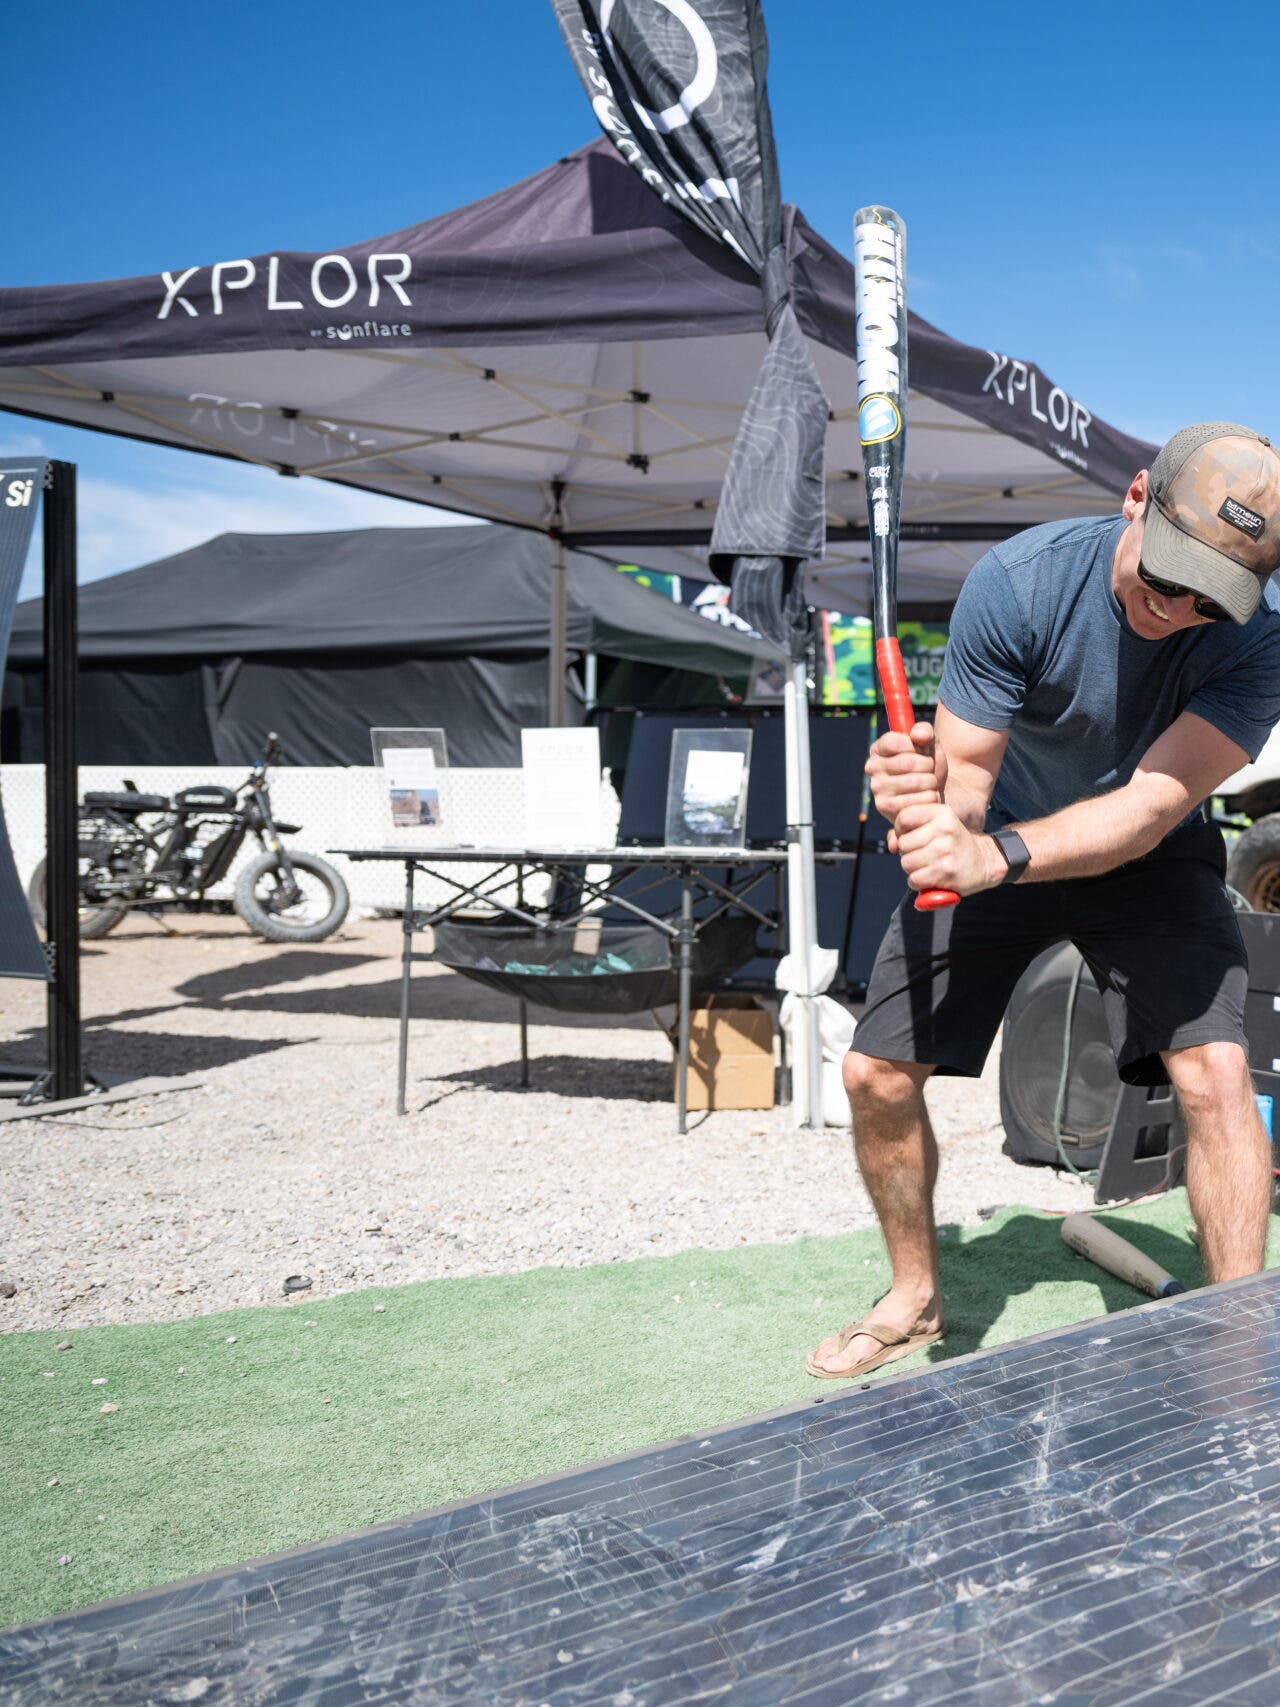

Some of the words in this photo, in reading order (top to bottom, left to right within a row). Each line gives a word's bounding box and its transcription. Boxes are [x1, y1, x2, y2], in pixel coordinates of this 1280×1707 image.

[157, 253, 412, 319] XPLOR
[855, 223, 899, 398] WORTH
[326, 321, 412, 341] sunflare
[982, 350, 1092, 449] XPLOR
